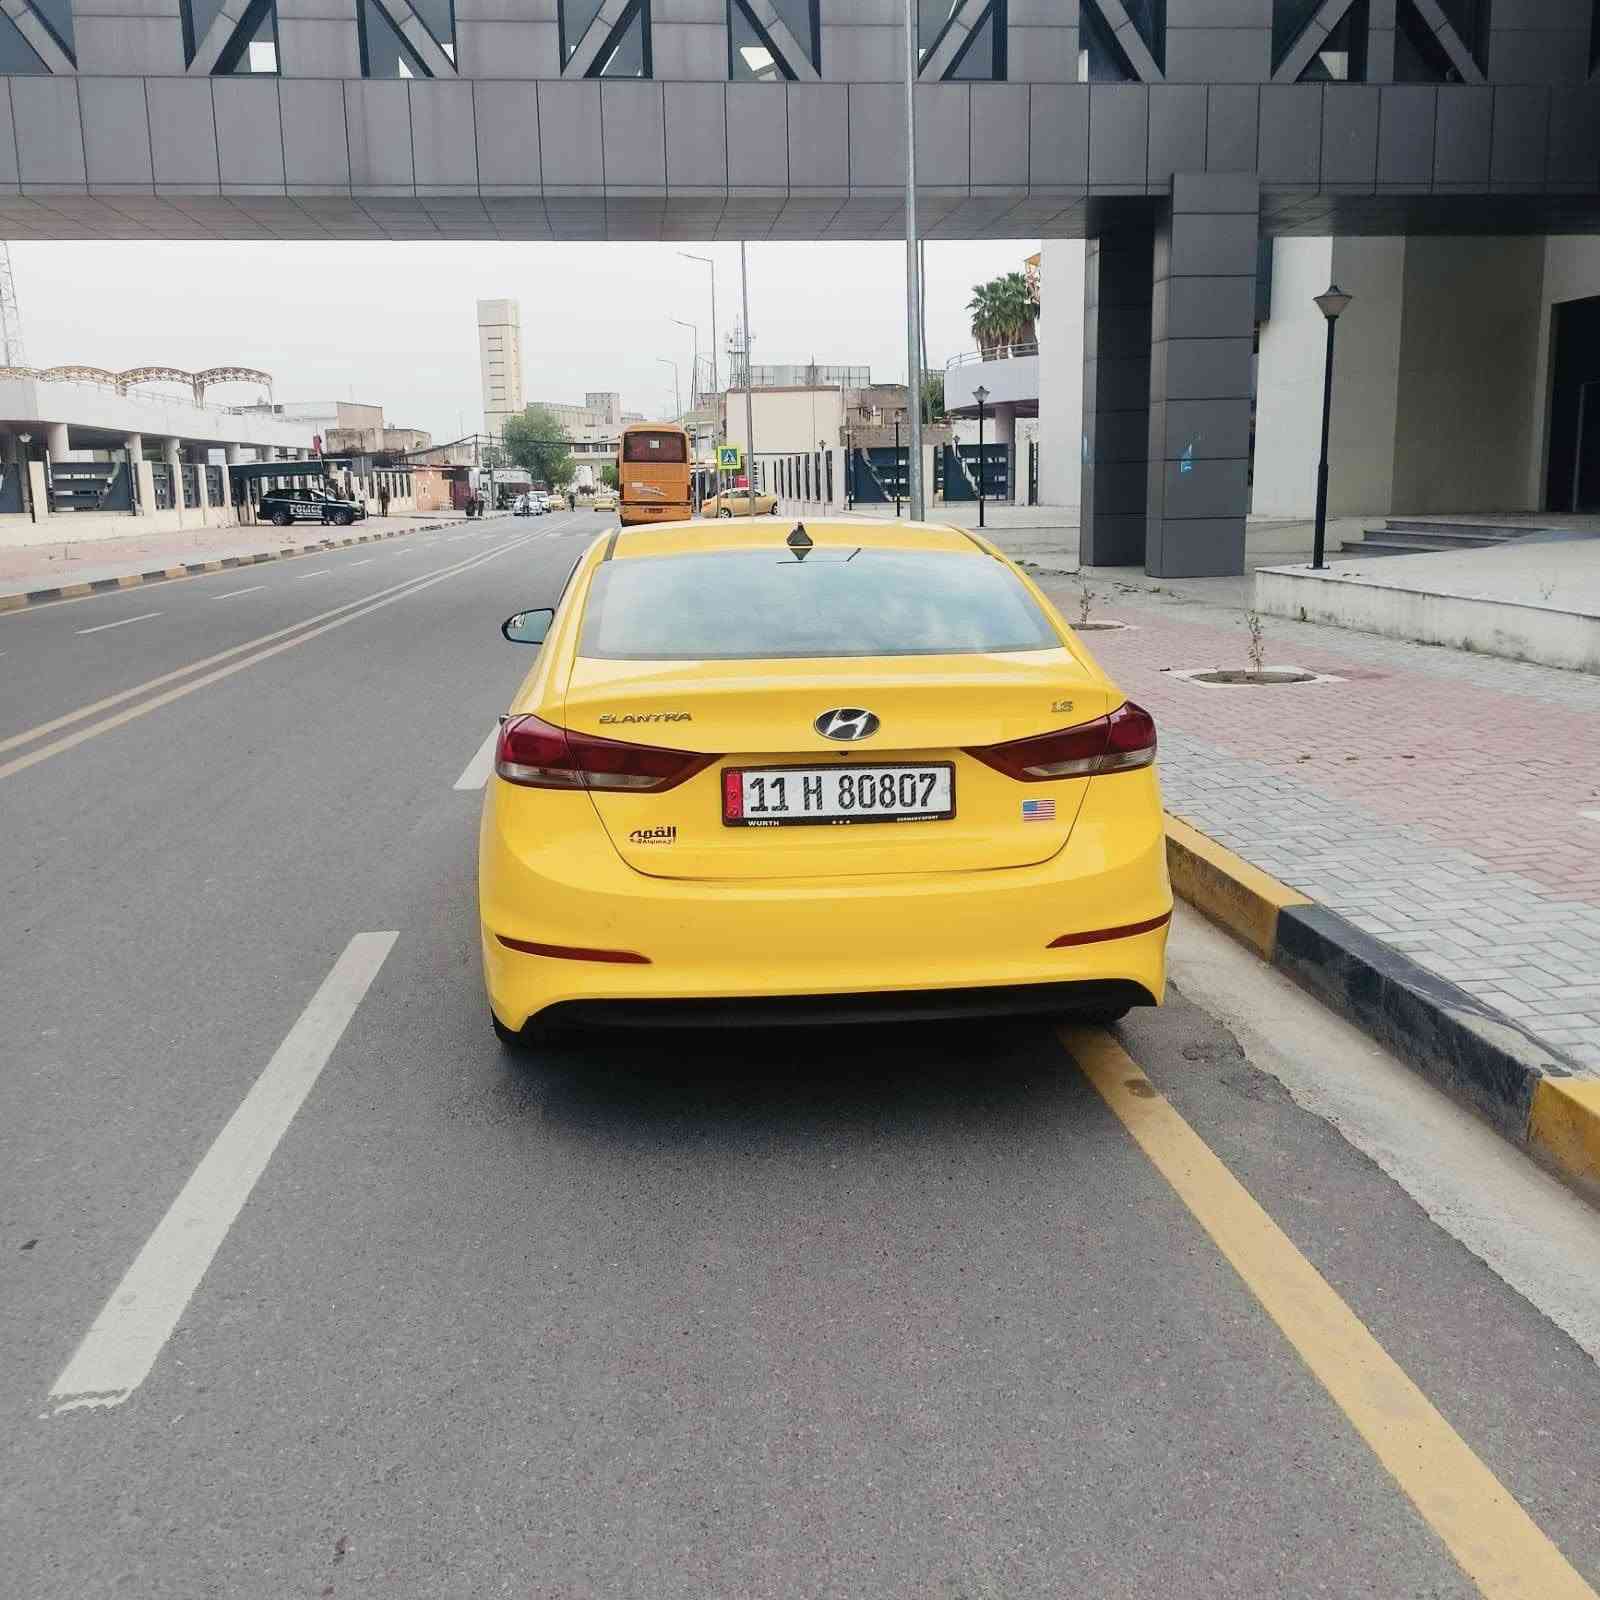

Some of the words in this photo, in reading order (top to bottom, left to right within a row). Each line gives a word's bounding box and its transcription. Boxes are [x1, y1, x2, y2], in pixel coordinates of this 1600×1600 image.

[289, 504, 322, 514] POLICE
[599, 712, 693, 724] ELANTRA
[749, 777, 789, 812] 11
[803, 775, 823, 811] H
[838, 773, 937, 810] 80807
